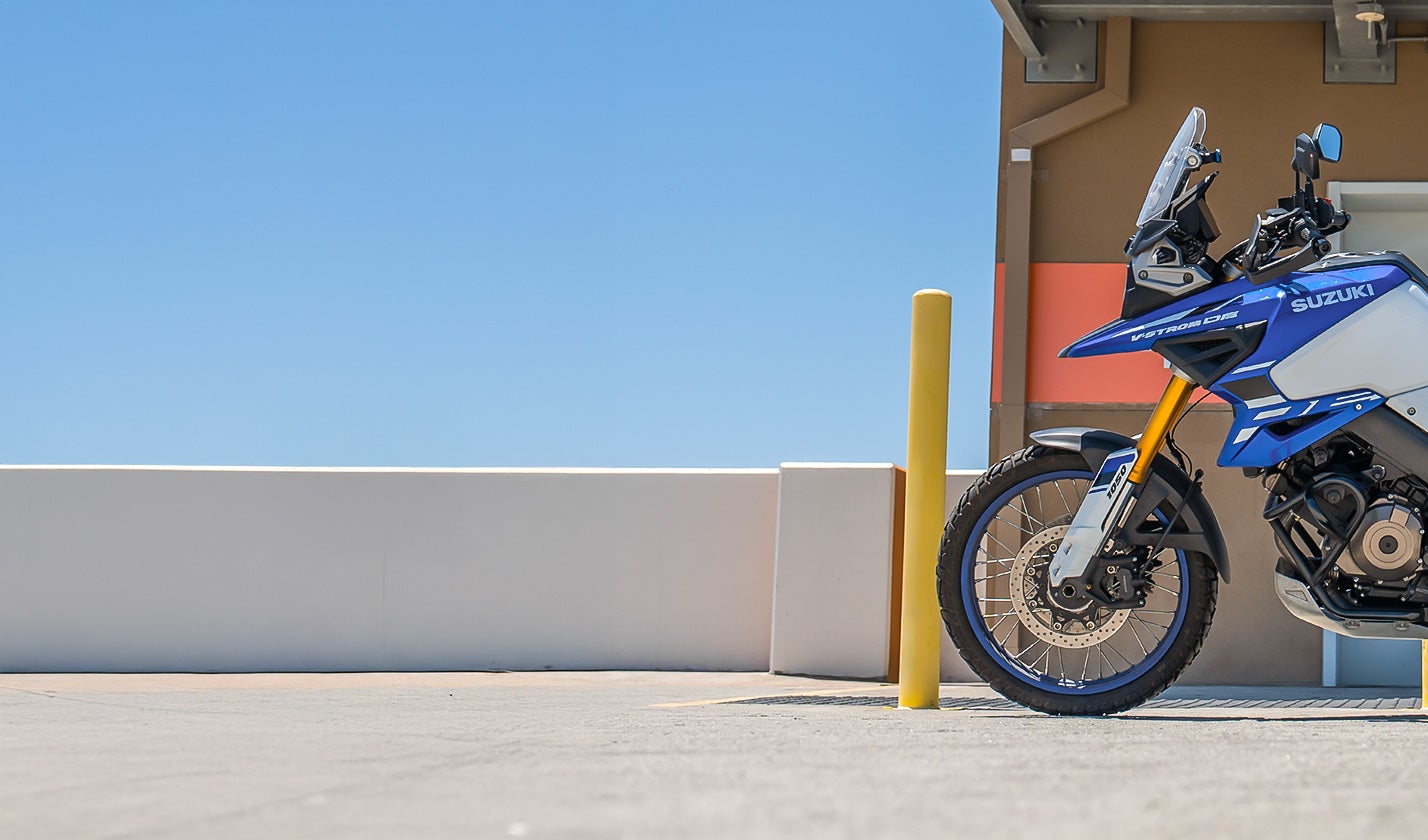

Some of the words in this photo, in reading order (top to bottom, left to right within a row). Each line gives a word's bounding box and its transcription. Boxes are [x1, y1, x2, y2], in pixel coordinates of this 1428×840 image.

[1290, 283, 1375, 313] SUZUKI
[1131, 319, 1202, 342] V-STROM
[1106, 464, 1127, 500] 1050
